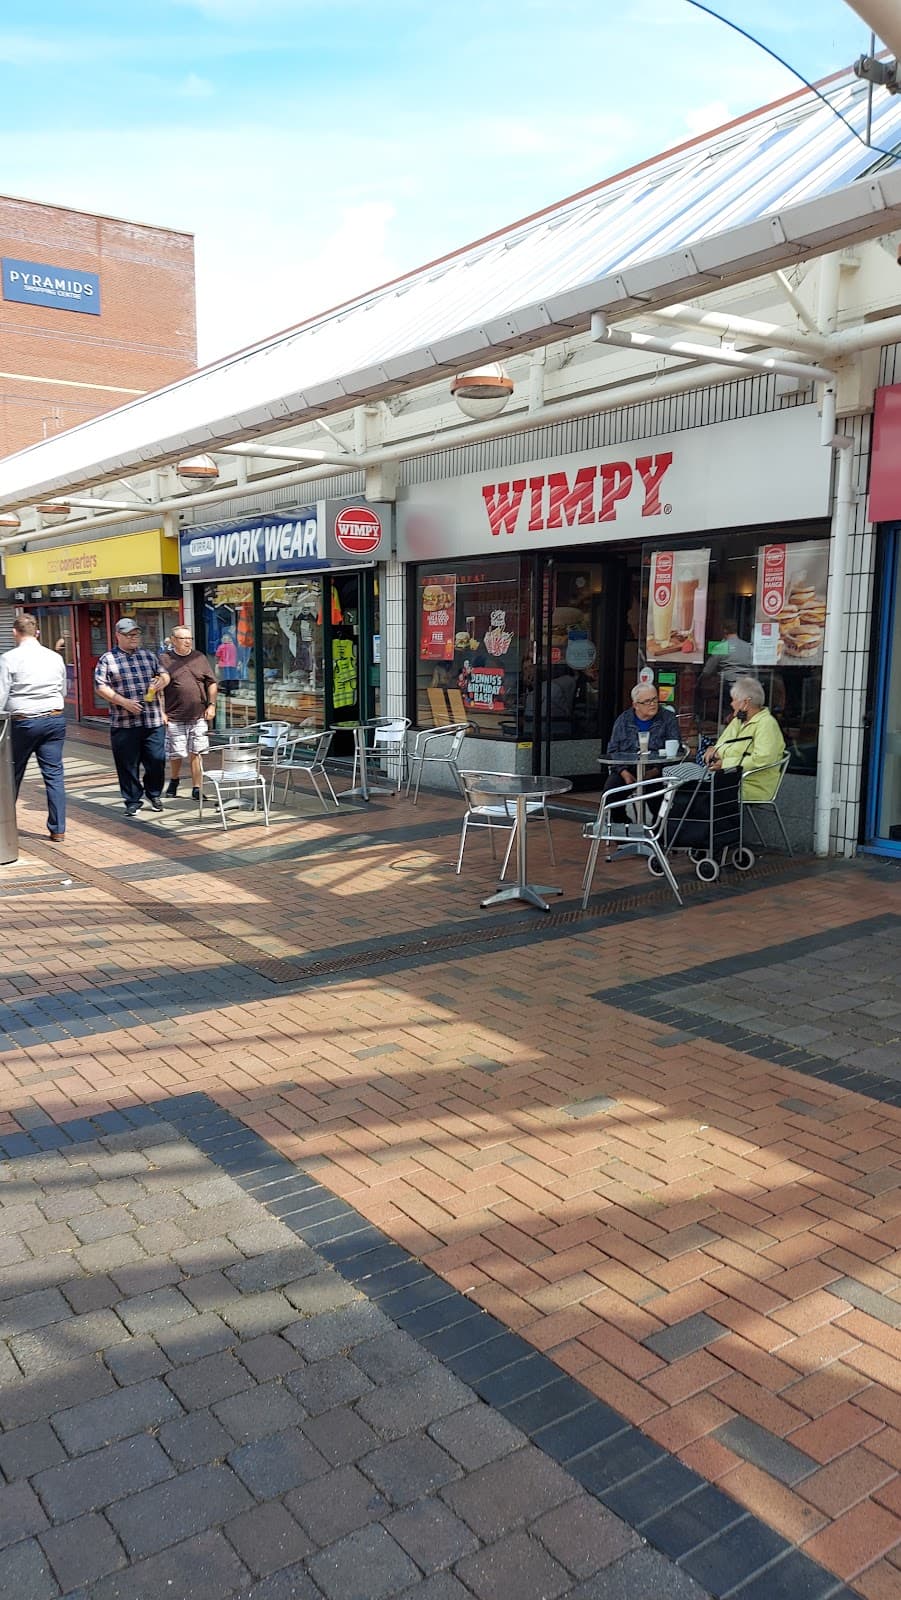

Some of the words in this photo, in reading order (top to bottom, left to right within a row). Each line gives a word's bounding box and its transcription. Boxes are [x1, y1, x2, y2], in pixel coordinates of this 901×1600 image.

[9, 270, 94, 296] PYRAMIDS
[481, 451, 673, 536] WIMPY
[338, 523, 380, 537] WIMPY
[215, 527, 262, 568] WORK
[264, 519, 317, 562] WEAR
[471, 673, 502, 686] DENNIS'S
[467, 683, 501, 695] BIRTHDAY
[474, 692, 493, 704] BASH
